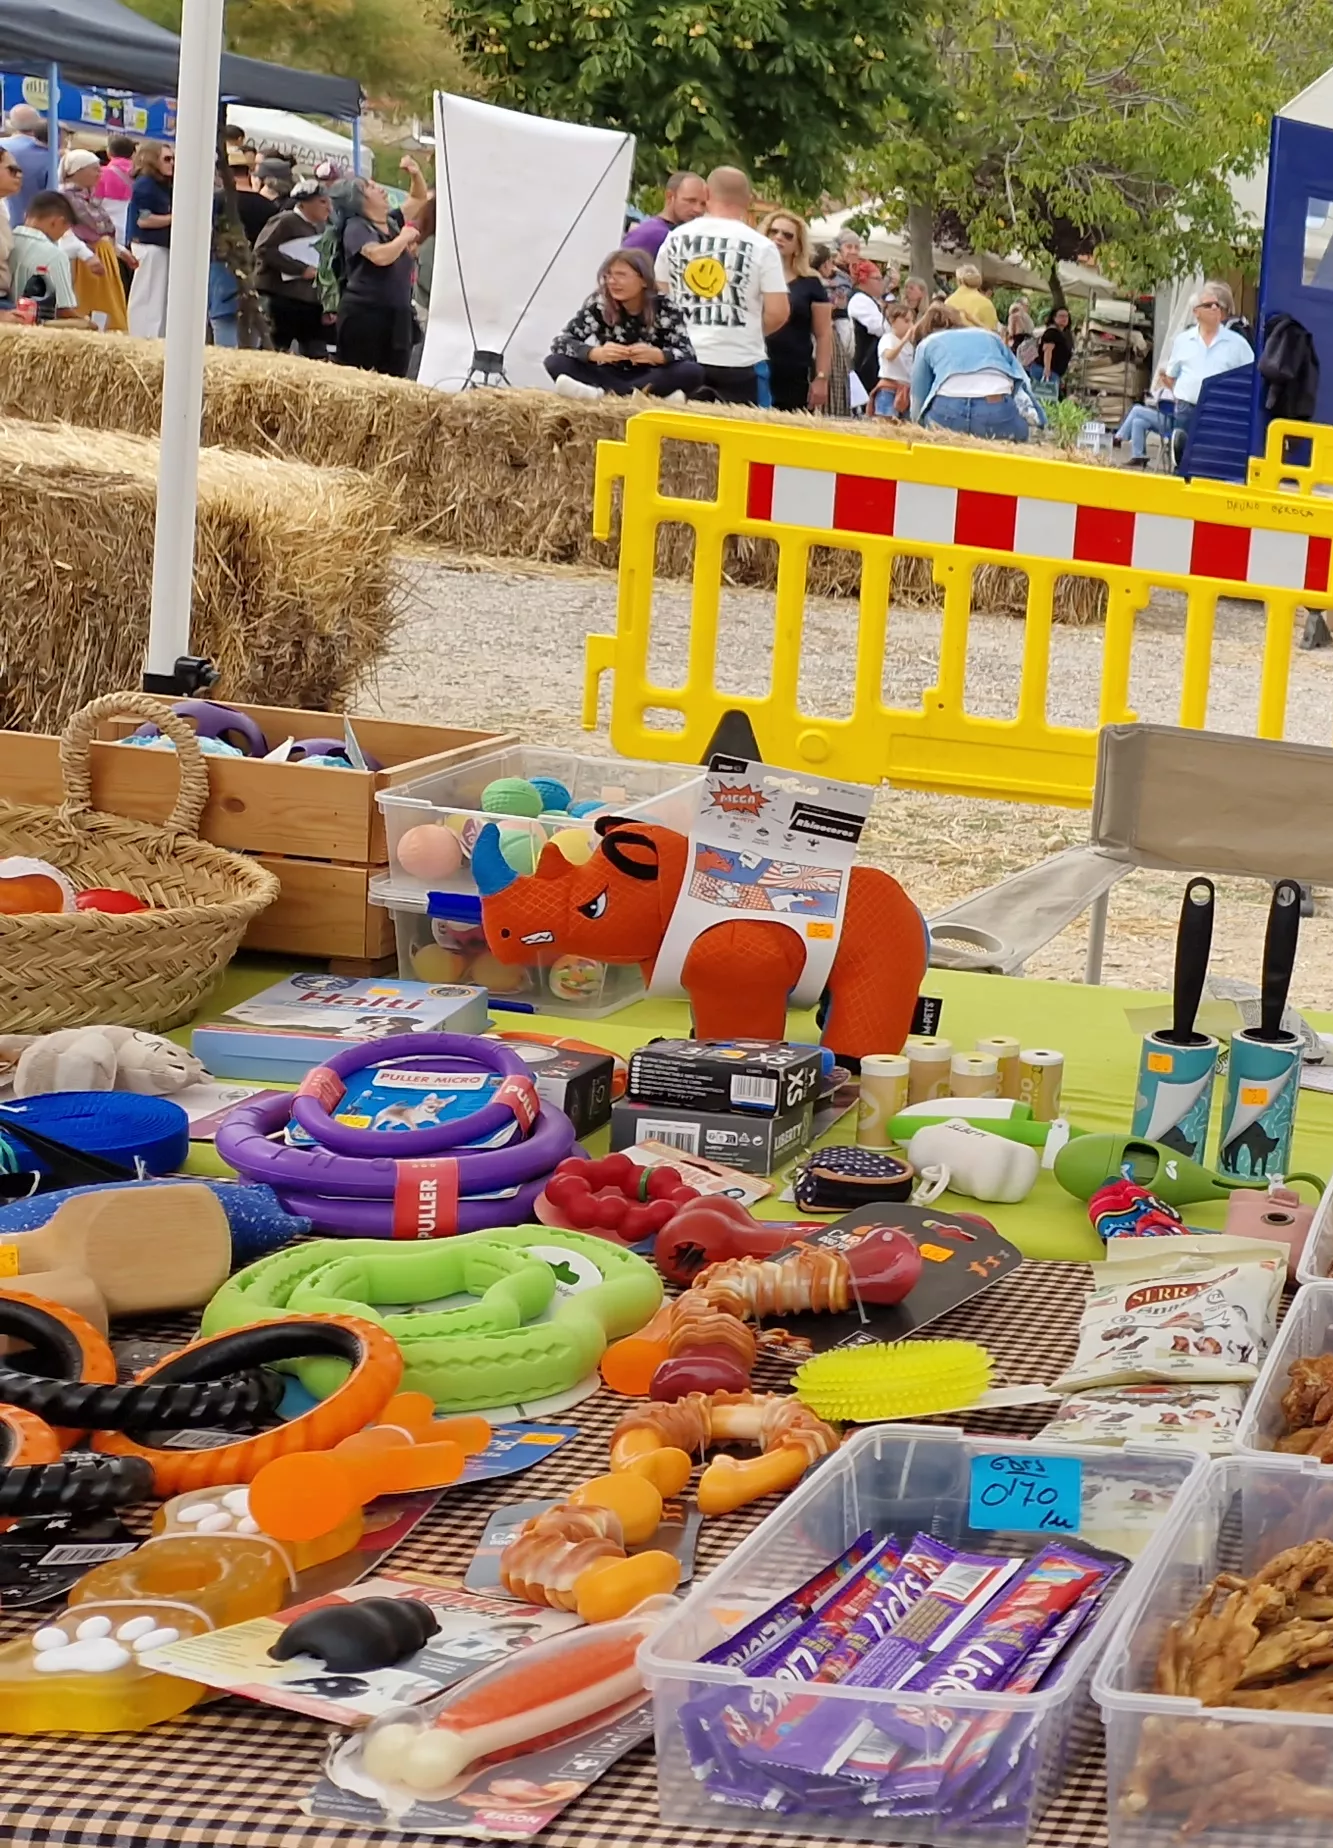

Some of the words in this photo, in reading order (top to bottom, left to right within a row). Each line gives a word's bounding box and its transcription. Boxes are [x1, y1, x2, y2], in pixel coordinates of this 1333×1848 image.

[720, 794, 756, 805] MEGA
[795, 816, 855, 838] Rhinoceros
[296, 991, 424, 1010] Halti
[380, 1072, 430, 1083] PULLER
[434, 1075, 481, 1084] MICRO
[417, 1178, 438, 1240] PULLER
[862, 1572, 925, 1640] Licks
[484, 1811, 543, 1824] BACON
